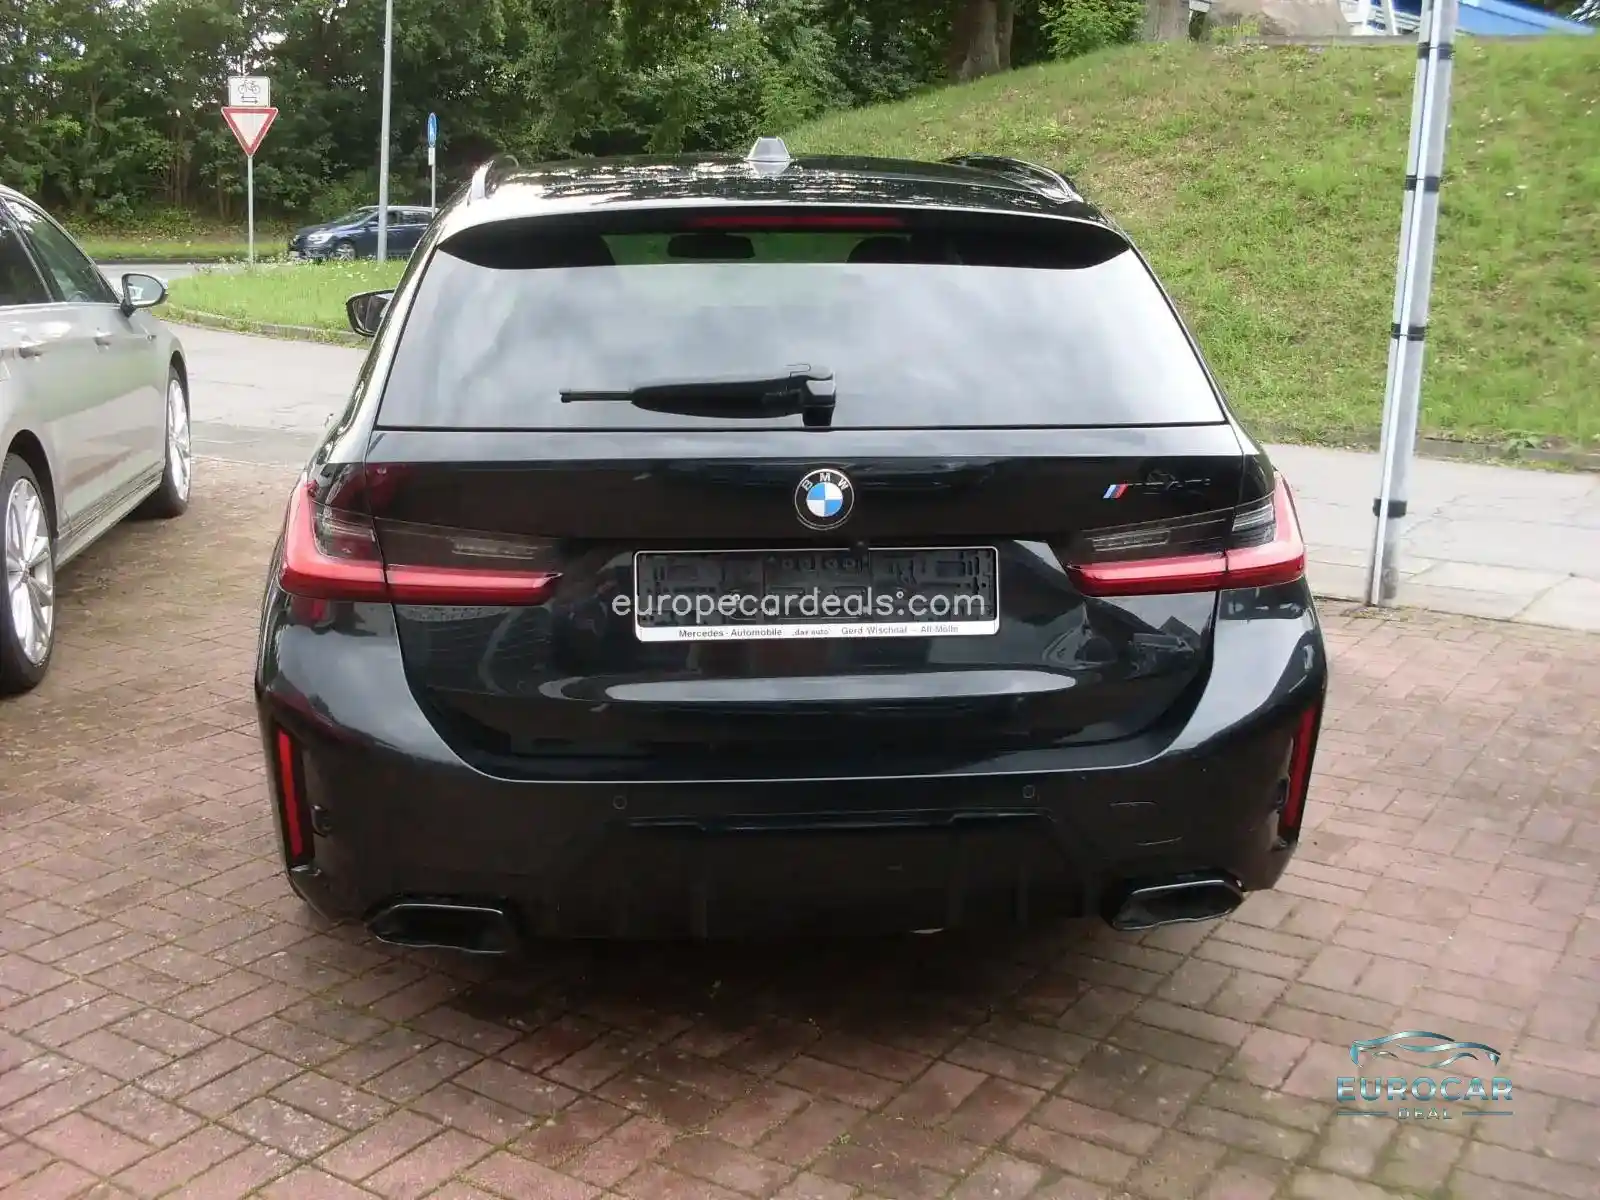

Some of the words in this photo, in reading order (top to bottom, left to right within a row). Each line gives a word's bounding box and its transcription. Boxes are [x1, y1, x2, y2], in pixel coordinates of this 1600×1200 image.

[801, 472, 849, 491] BMW
[678, 629, 724, 638] Mercedes
[730, 628, 783, 637] Automobile
